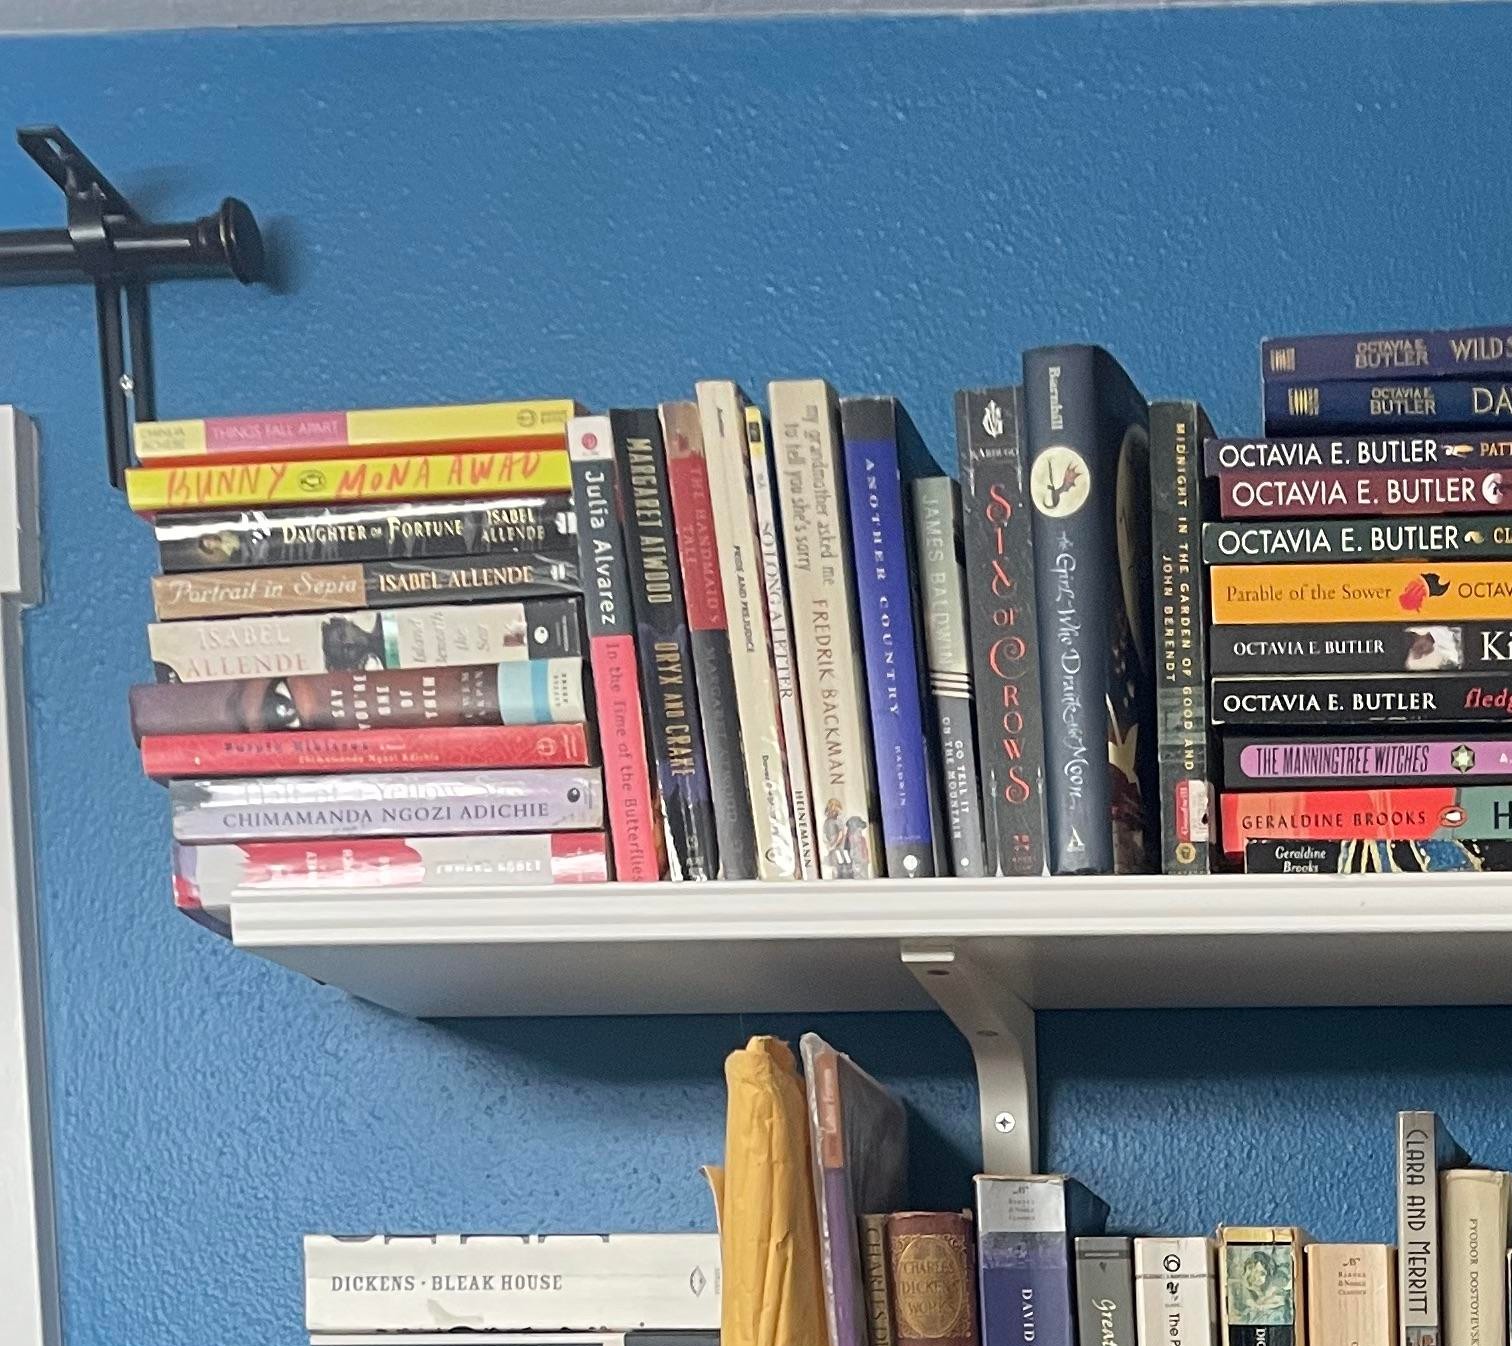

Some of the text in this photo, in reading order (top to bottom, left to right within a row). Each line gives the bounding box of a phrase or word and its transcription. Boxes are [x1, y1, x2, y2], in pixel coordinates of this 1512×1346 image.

[1450, 338, 1503, 362] WILD
[1220, 440, 1438, 467] OCTAVIA E. BUTLER
[167, 464, 288, 504] BUNNY
[583, 470, 617, 625] Julia Alvarez
[378, 565, 534, 593] ISABEL ALLENDE
[223, 802, 550, 828] CHIMAMANDA NGOZI ADICHIE
[331, 1274, 563, 1293] DICKENS BLEAK HOUSE
[1020, 1288, 1035, 1342] DAVID
[1168, 1313, 1181, 1339] The
